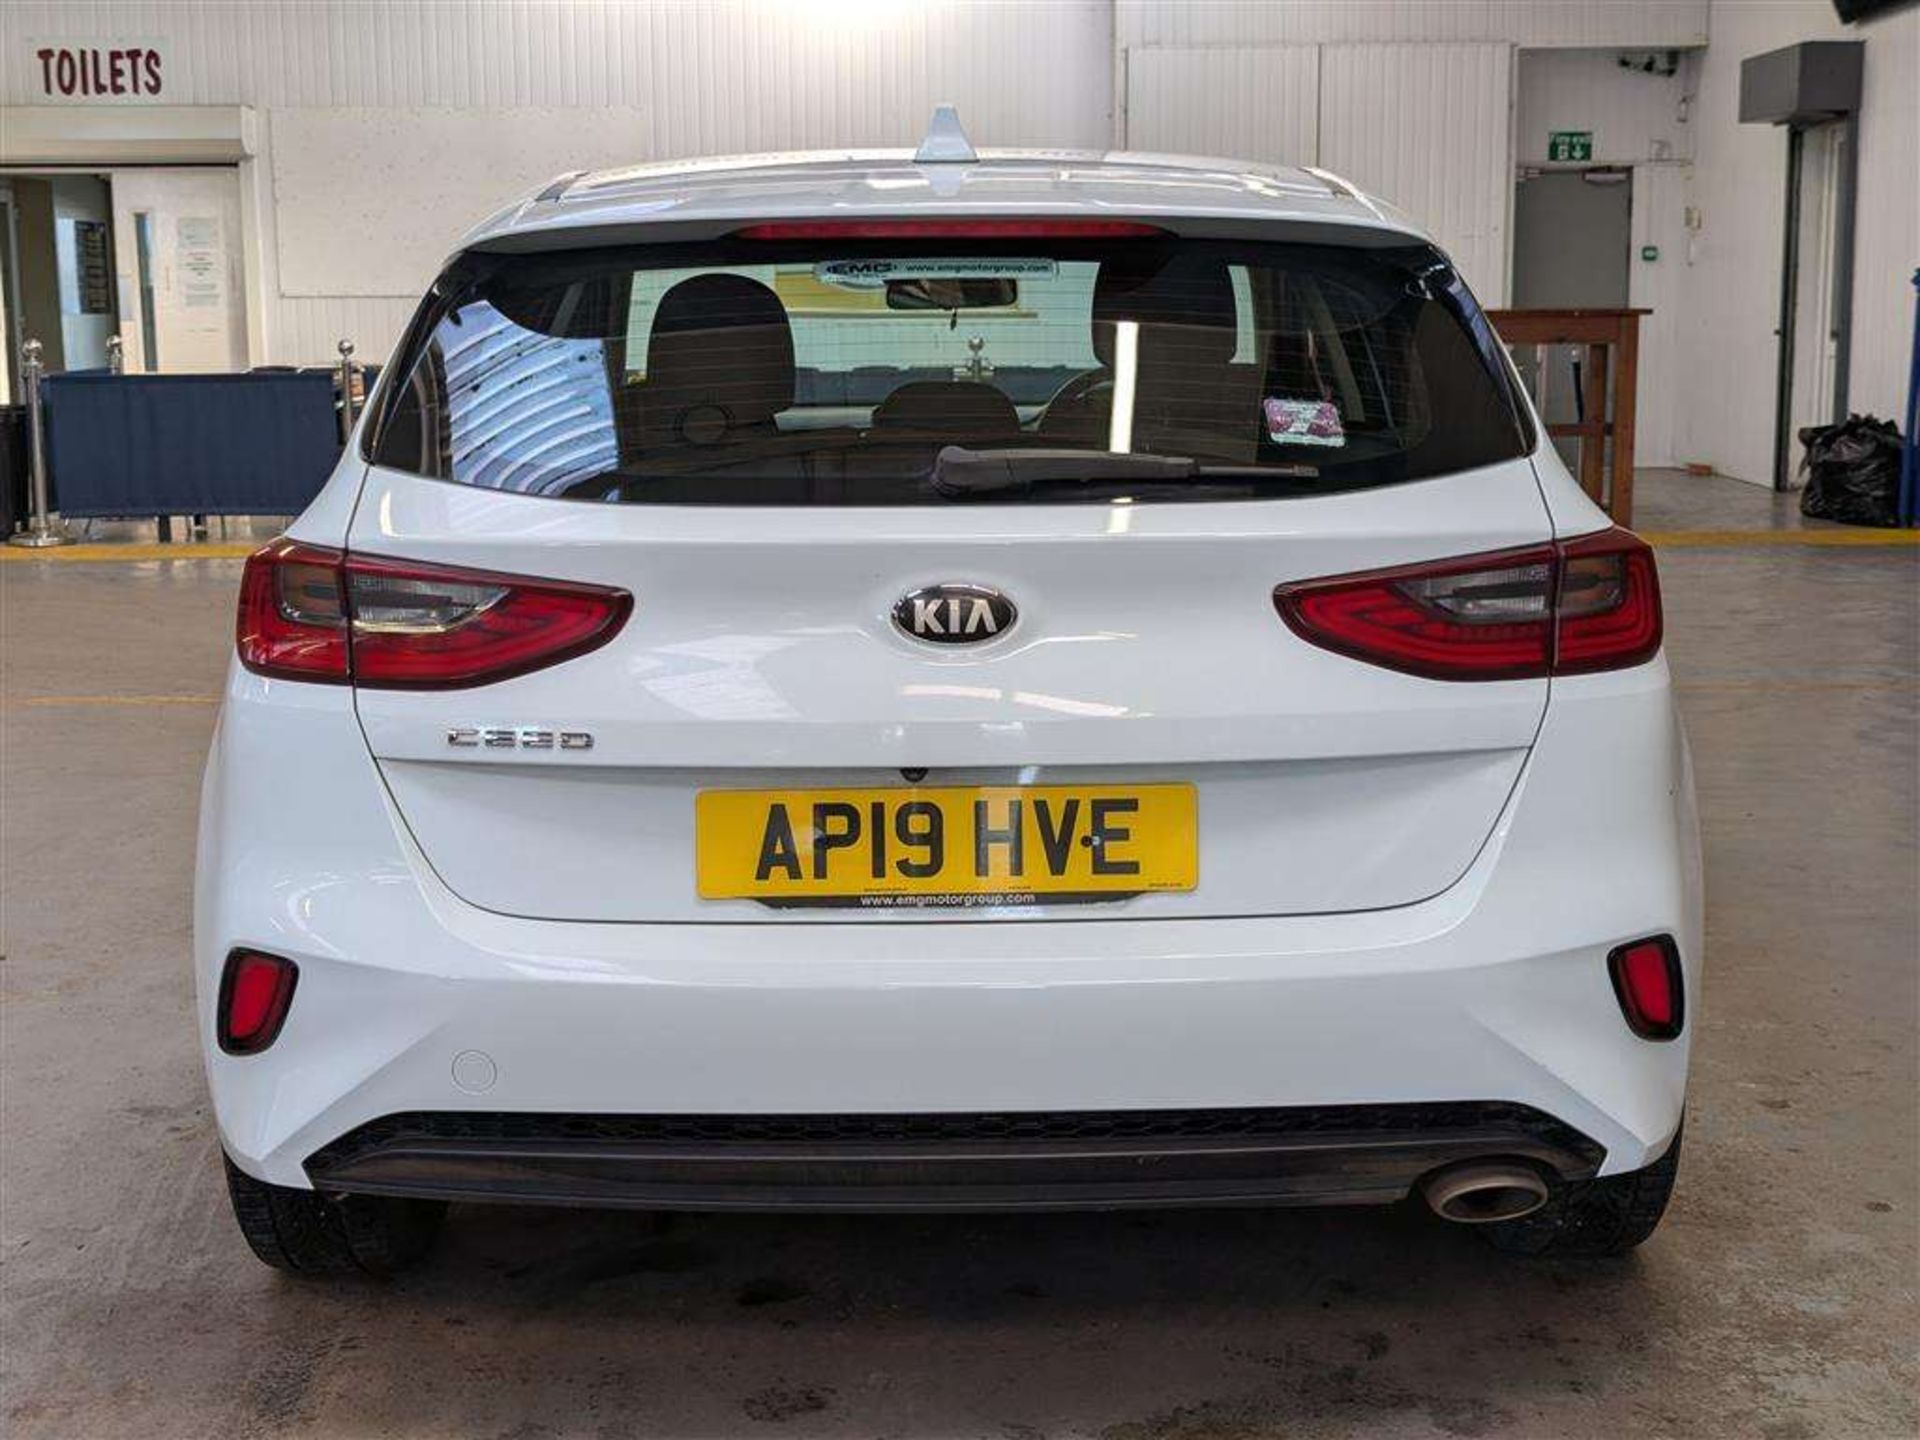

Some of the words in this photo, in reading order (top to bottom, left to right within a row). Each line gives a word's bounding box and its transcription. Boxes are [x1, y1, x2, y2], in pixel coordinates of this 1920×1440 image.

[37, 47, 163, 97] TOILETS
[829, 262, 889, 275] EMG
[905, 263, 1050, 275] www.emgmotorgroup.com
[912, 599, 998, 634] KIA
[754, 801, 944, 881] AP19
[973, 797, 1140, 877] HVE
[860, 891, 1036, 907] www.emgmotorgroup.com
